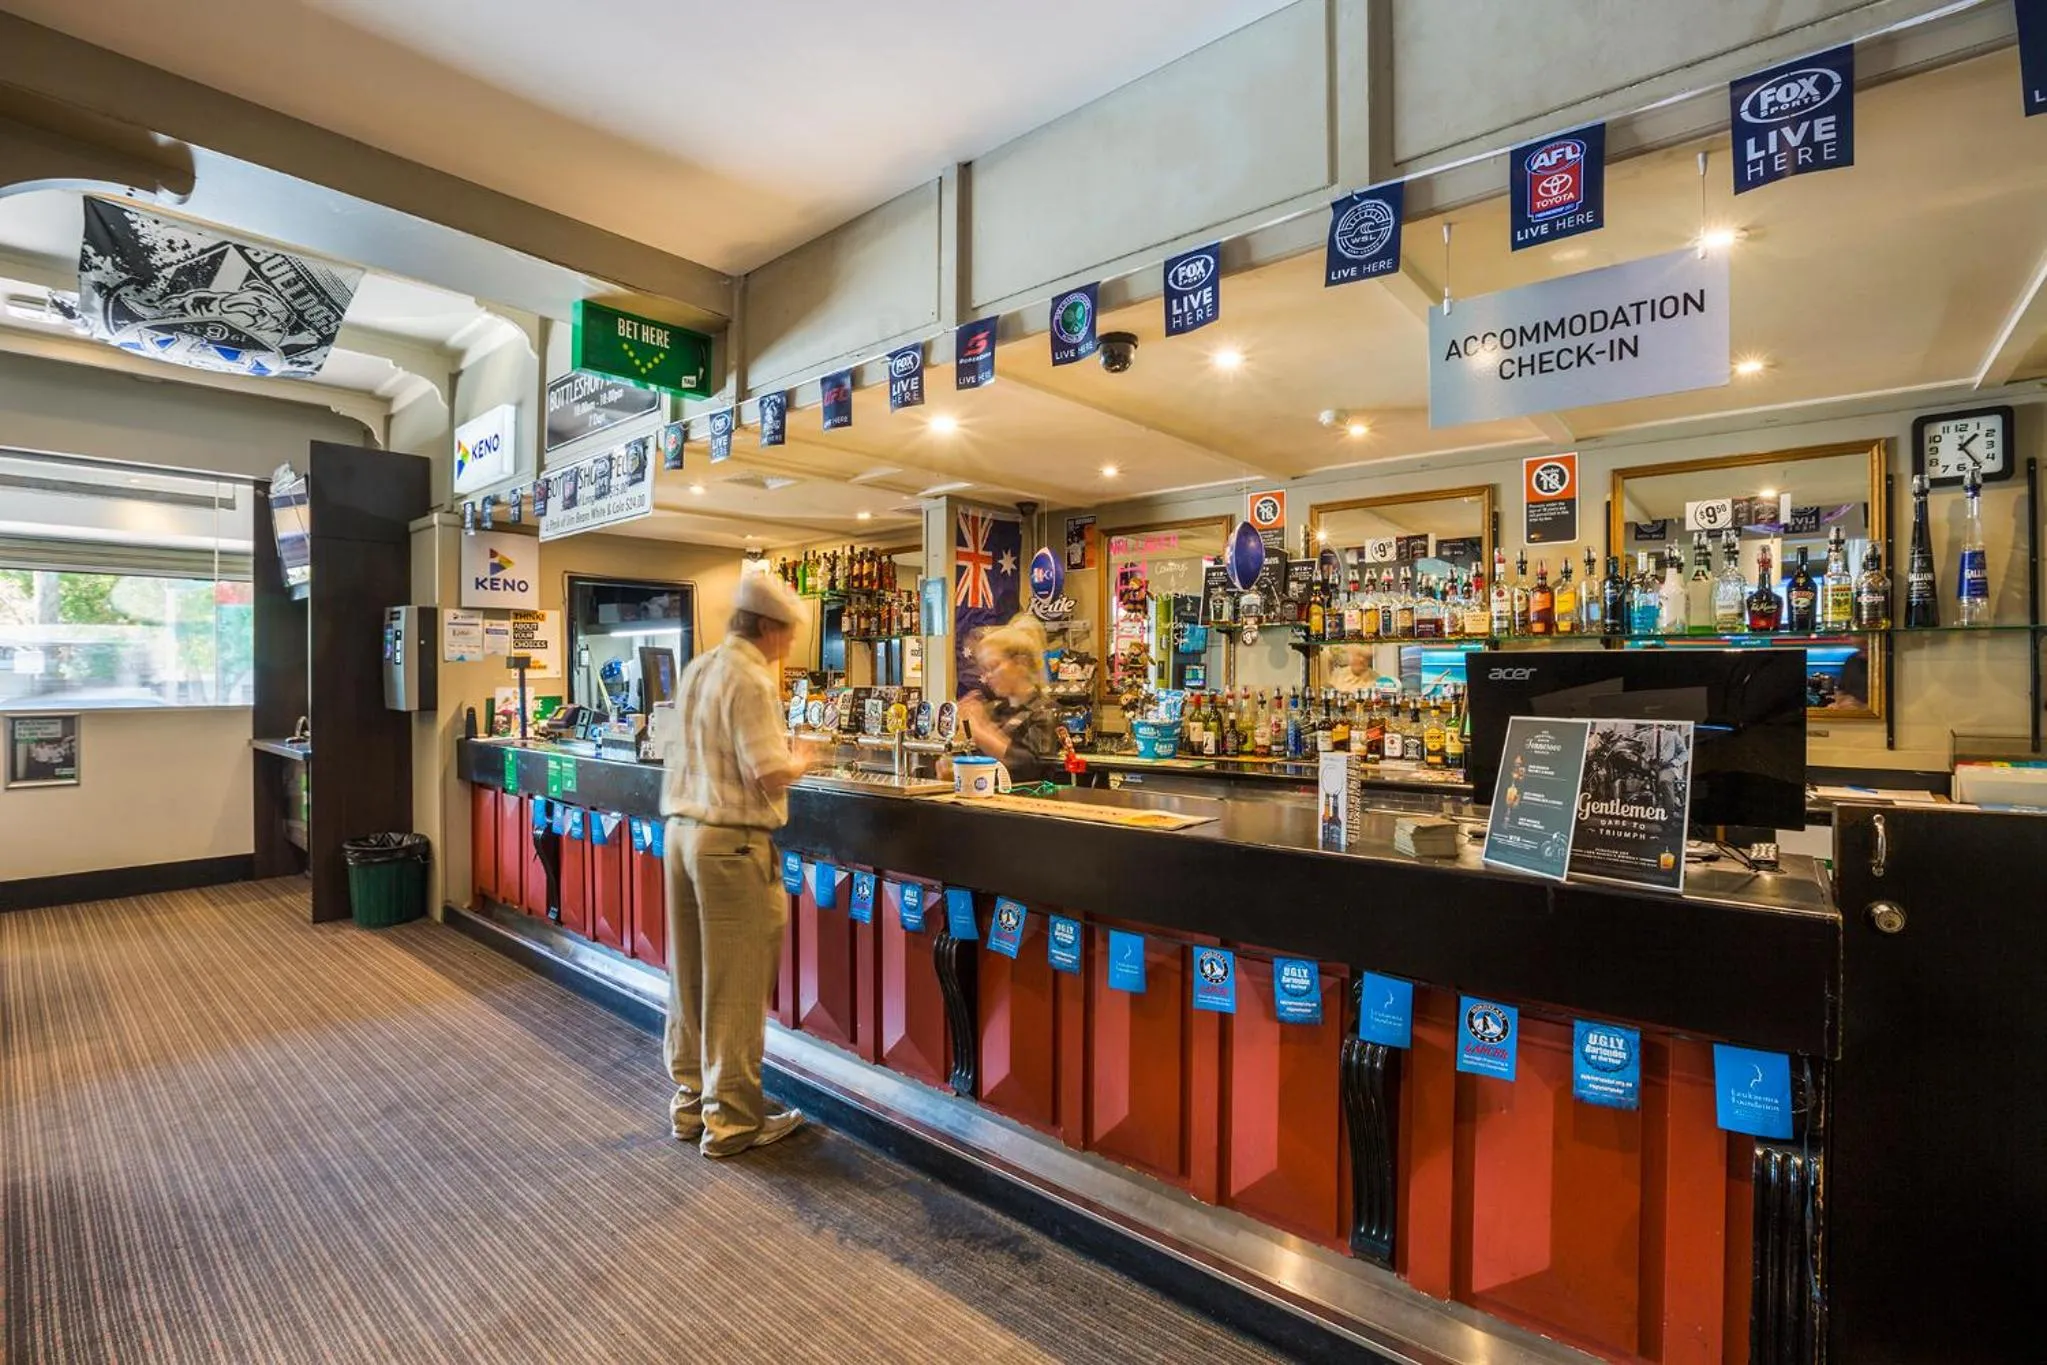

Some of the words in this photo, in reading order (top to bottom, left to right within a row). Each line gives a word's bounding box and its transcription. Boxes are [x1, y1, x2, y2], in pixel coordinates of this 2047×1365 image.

[1760, 74, 1820, 111] FOX
[1760, 94, 1821, 118] SPORTS
[1746, 115, 1837, 161] LIVE
[1531, 145, 1581, 170] AFL
[1747, 141, 1837, 181] HERE
[1536, 192, 1575, 209] TOYOTA
[1516, 223, 1549, 241] LIVE
[1556, 211, 1594, 231] HERE
[1350, 234, 1377, 244] WSL
[1177, 258, 1206, 284] FOX
[1331, 266, 1358, 280] LIVE
[1362, 258, 1393, 274] HERE
[1171, 286, 1213, 315] LIVE
[1172, 303, 1213, 328] HERE
[617, 317, 639, 340] BET
[641, 324, 670, 349] HERE
[1445, 289, 1705, 361] ACCOMMODATION
[1055, 349, 1075, 360] LIVE
[1499, 335, 1639, 380] CHECK-IN
[892, 376, 919, 396] LIVE
[959, 375, 976, 385] LIVE
[892, 389, 919, 404] HERE
[1955, 424, 1969, 433] 12
[1976, 422, 1980, 430] 1
[1985, 429, 1996, 437] 2
[471, 434, 500, 462] KENO
[1929, 435, 1942, 444] 10
[1986, 440, 1995, 449] 3
[1929, 447, 1939, 455] 9
[1929, 459, 1939, 467] 8
[1941, 465, 1950, 473] 7
[1957, 464, 1967, 472] 6
[475, 577, 529, 593] KENO
[1488, 668, 1537, 680] acer
[1578, 792, 1668, 821] Gentlemen
[1599, 828, 1646, 840] TRIUMPH
